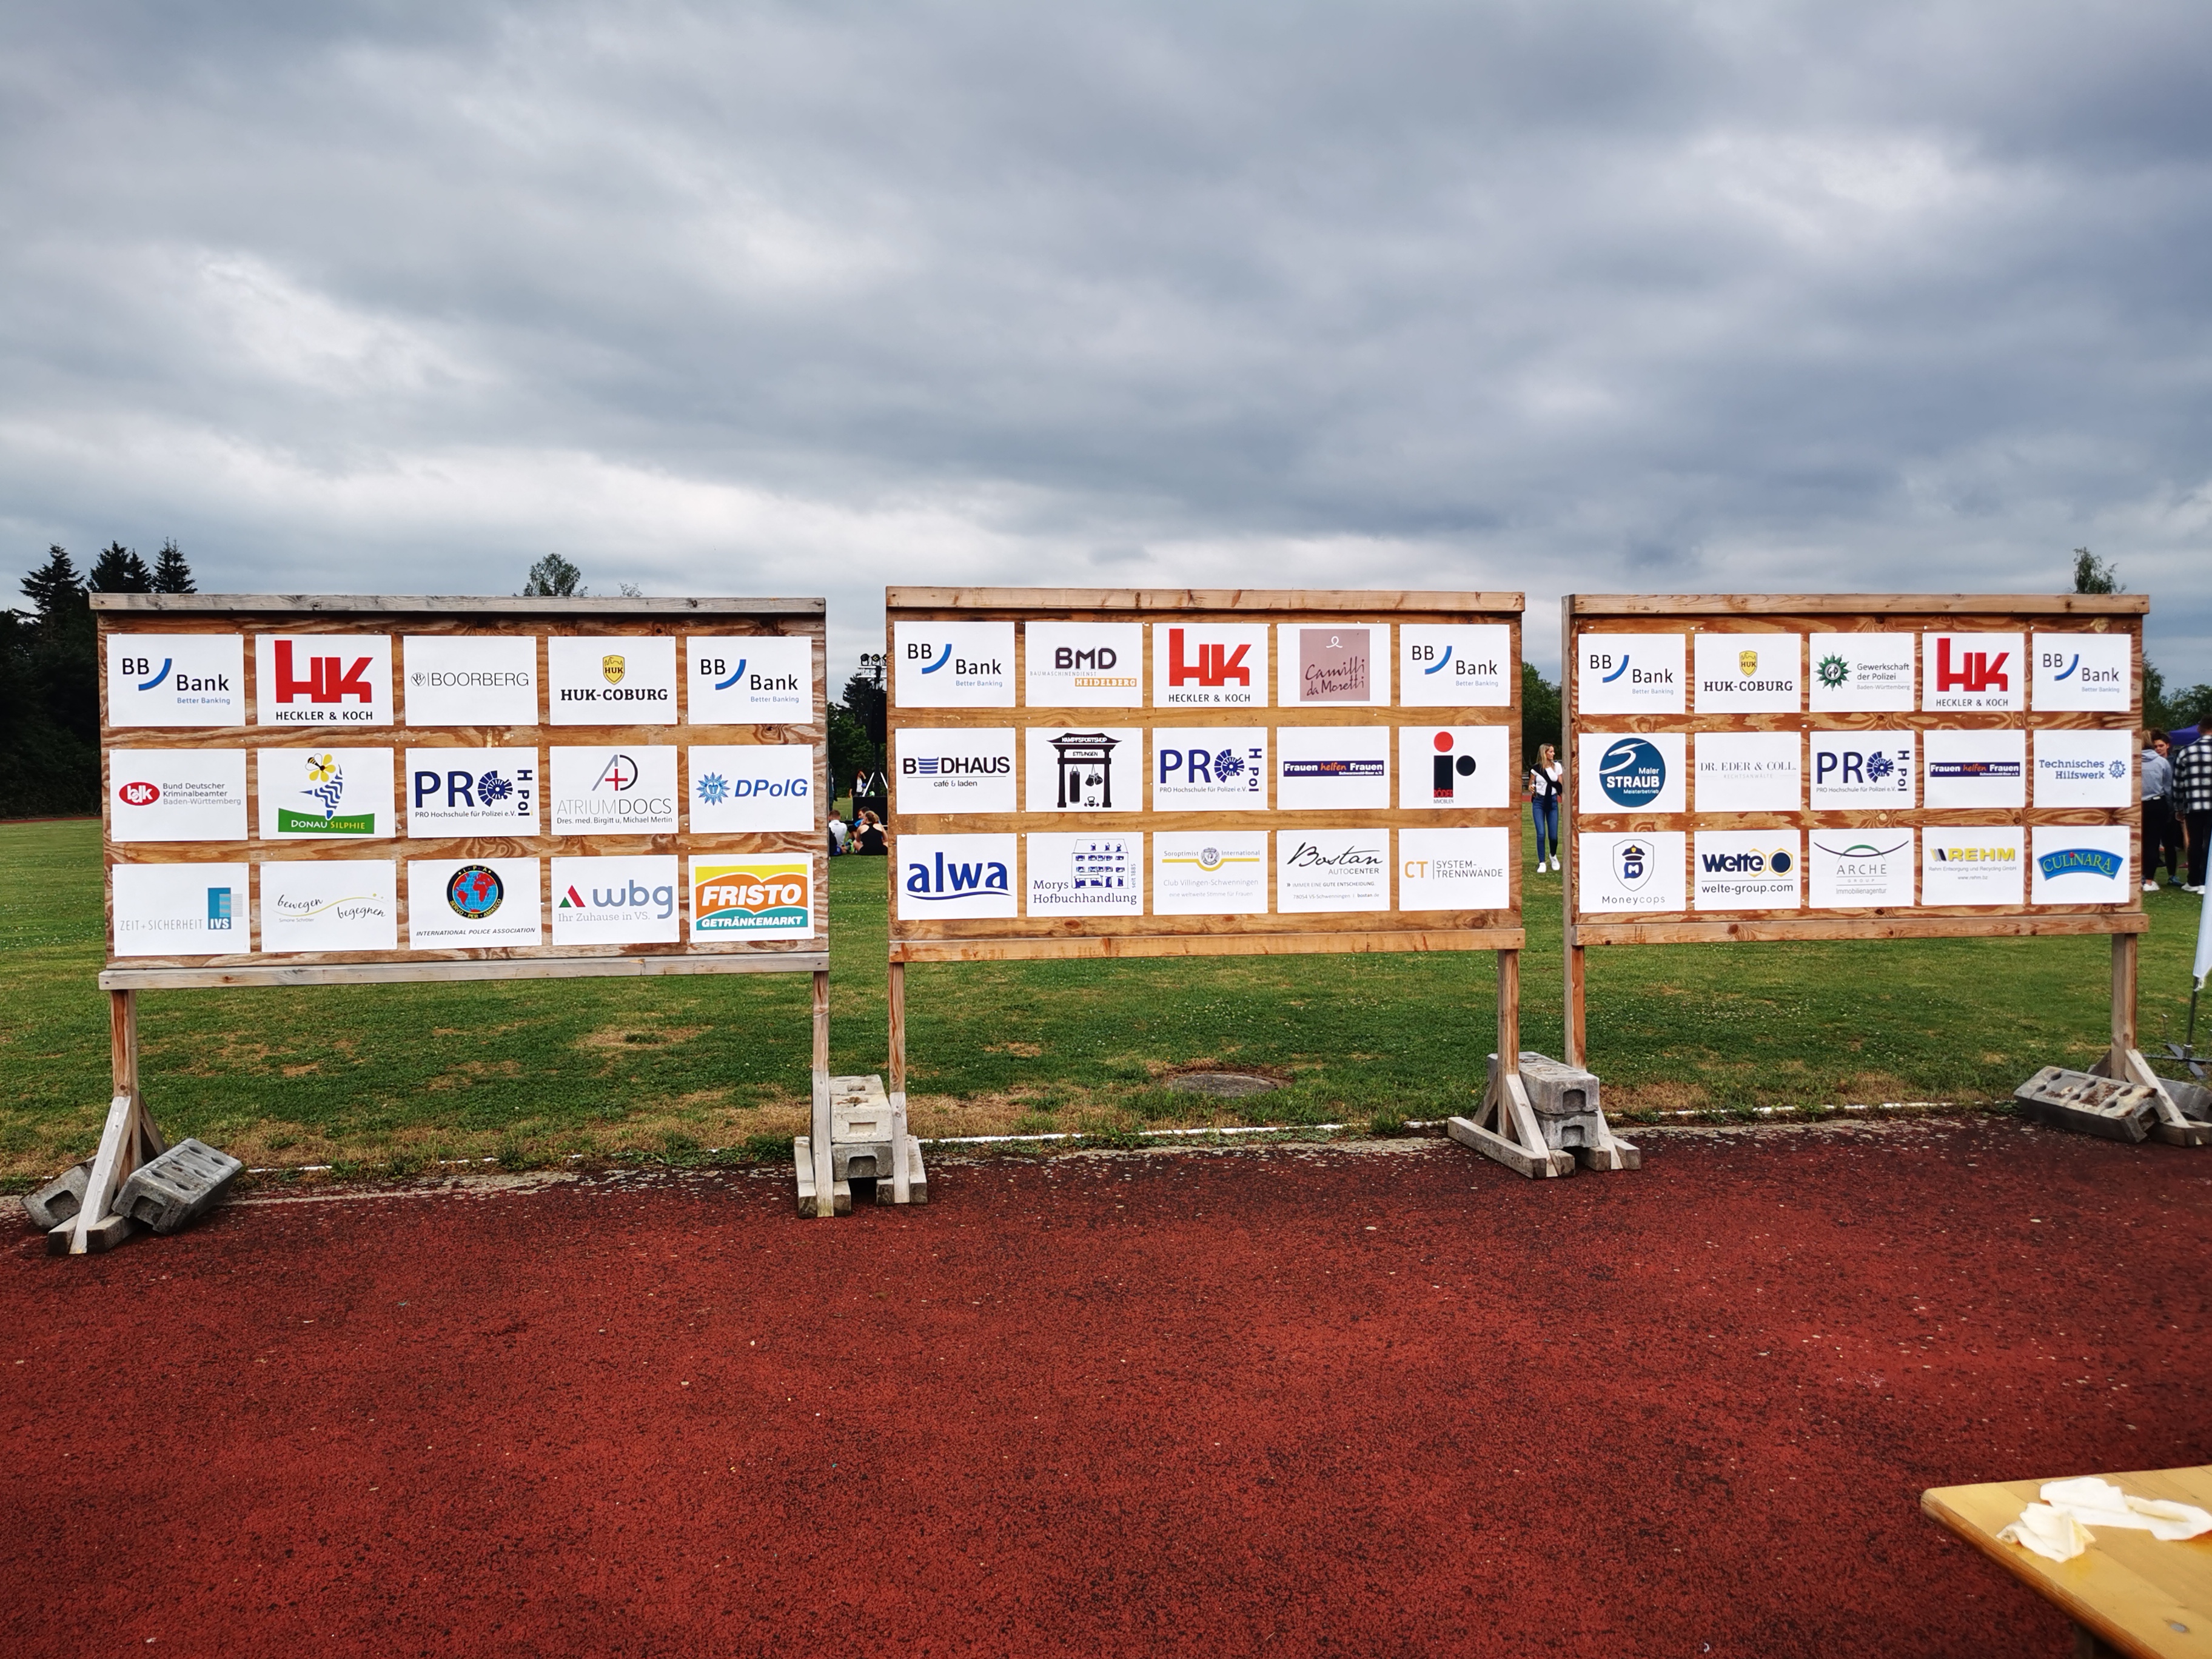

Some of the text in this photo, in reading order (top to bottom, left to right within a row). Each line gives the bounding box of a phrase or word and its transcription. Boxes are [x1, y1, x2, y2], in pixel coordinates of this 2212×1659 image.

[908, 644, 932, 659] BB
[1055, 647, 1116, 669] BMD
[1412, 646, 1434, 660] BB
[122, 658, 150, 675] BB
[701, 659, 726, 675] BB
[956, 659, 1002, 674] Bank
[1305, 655, 1364, 680] Camilli
[1456, 660, 1497, 675] Bank
[1590, 655, 1612, 669] BB
[2043, 654, 2063, 668] BB
[432, 672, 529, 686] BOORBERG
[751, 674, 798, 690] Bank
[1632, 668, 1673, 683] Bank
[2082, 668, 2119, 682] Bank
[176, 674, 229, 691] Bank
[1307, 674, 1364, 696] da Moretti
[1704, 681, 1793, 691] HUK-COBURG
[561, 689, 668, 700] HUK-COBURG
[343, 711, 372, 720] KOCH
[1321, 762, 1346, 771] helfen
[1701, 763, 1717, 771] DR.
[1722, 762, 1750, 771] EDER
[1767, 762, 1796, 770] COLL.
[2039, 760, 2105, 768] Technisches
[1607, 776, 1659, 788] STRAUB
[2056, 771, 2105, 779] Hilfswerk
[735, 779, 808, 797] DPolG
[557, 799, 671, 815] ATRIUMDOCS
[1287, 842, 1382, 867] Bostan
[1948, 848, 2016, 861] REHM
[907, 852, 1008, 893] alwa
[1404, 861, 1428, 878] CT
[1436, 868, 1503, 878] TRENNWÄNDE
[1837, 864, 1887, 875] ARCHE
[1033, 880, 1068, 892] Morys
[1701, 884, 1794, 894] welte-group.com
[593, 879, 673, 919] wbg
[702, 883, 802, 906] FRISTO
[1033, 893, 1137, 905] Hofbuchhandlung
[1602, 896, 1665, 905] Moneycops
[278, 894, 323, 913] bewegen
[337, 907, 386, 920] begegnen
[576, 913, 619, 921] Zuhause
[210, 918, 229, 929] IVS
[702, 916, 803, 927] GETRÄNKEMARKT
